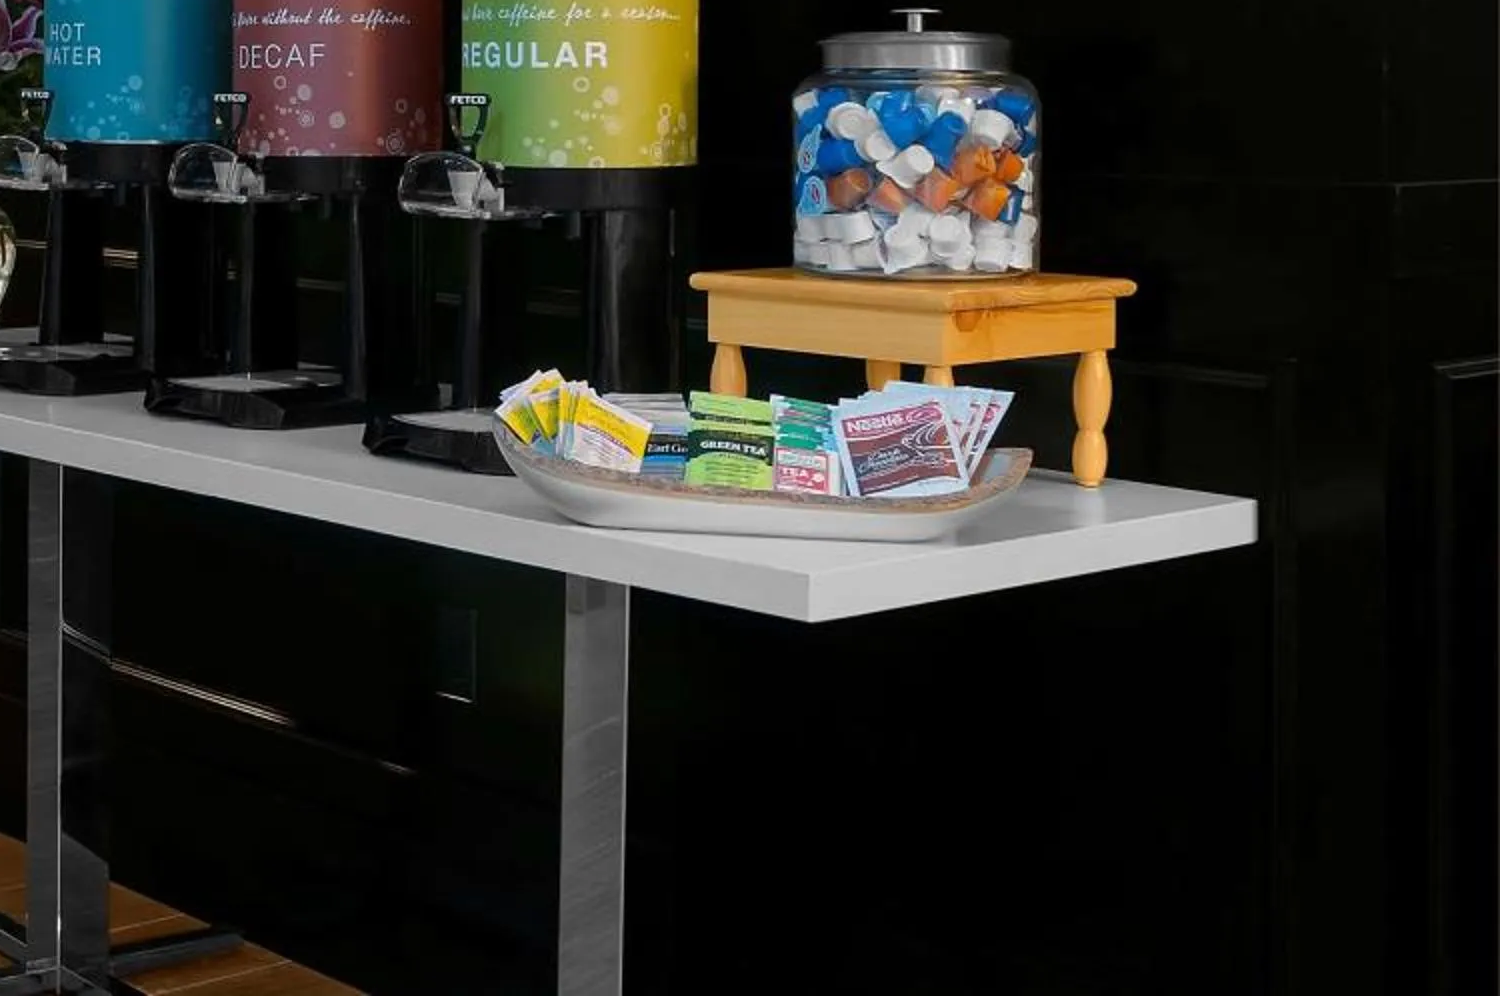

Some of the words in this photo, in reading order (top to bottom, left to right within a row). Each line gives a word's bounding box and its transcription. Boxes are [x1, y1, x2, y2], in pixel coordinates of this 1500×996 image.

[319, 7, 344, 25] the
[564, 1, 593, 27] for
[49, 22, 85, 42] HOT
[239, 43, 326, 69] DECAF
[462, 41, 608, 68] REGULAR
[213, 93, 247, 103] FETCO
[451, 94, 487, 105] FETCO
[699, 439, 741, 453] GREEN
[743, 442, 768, 457] TEA
